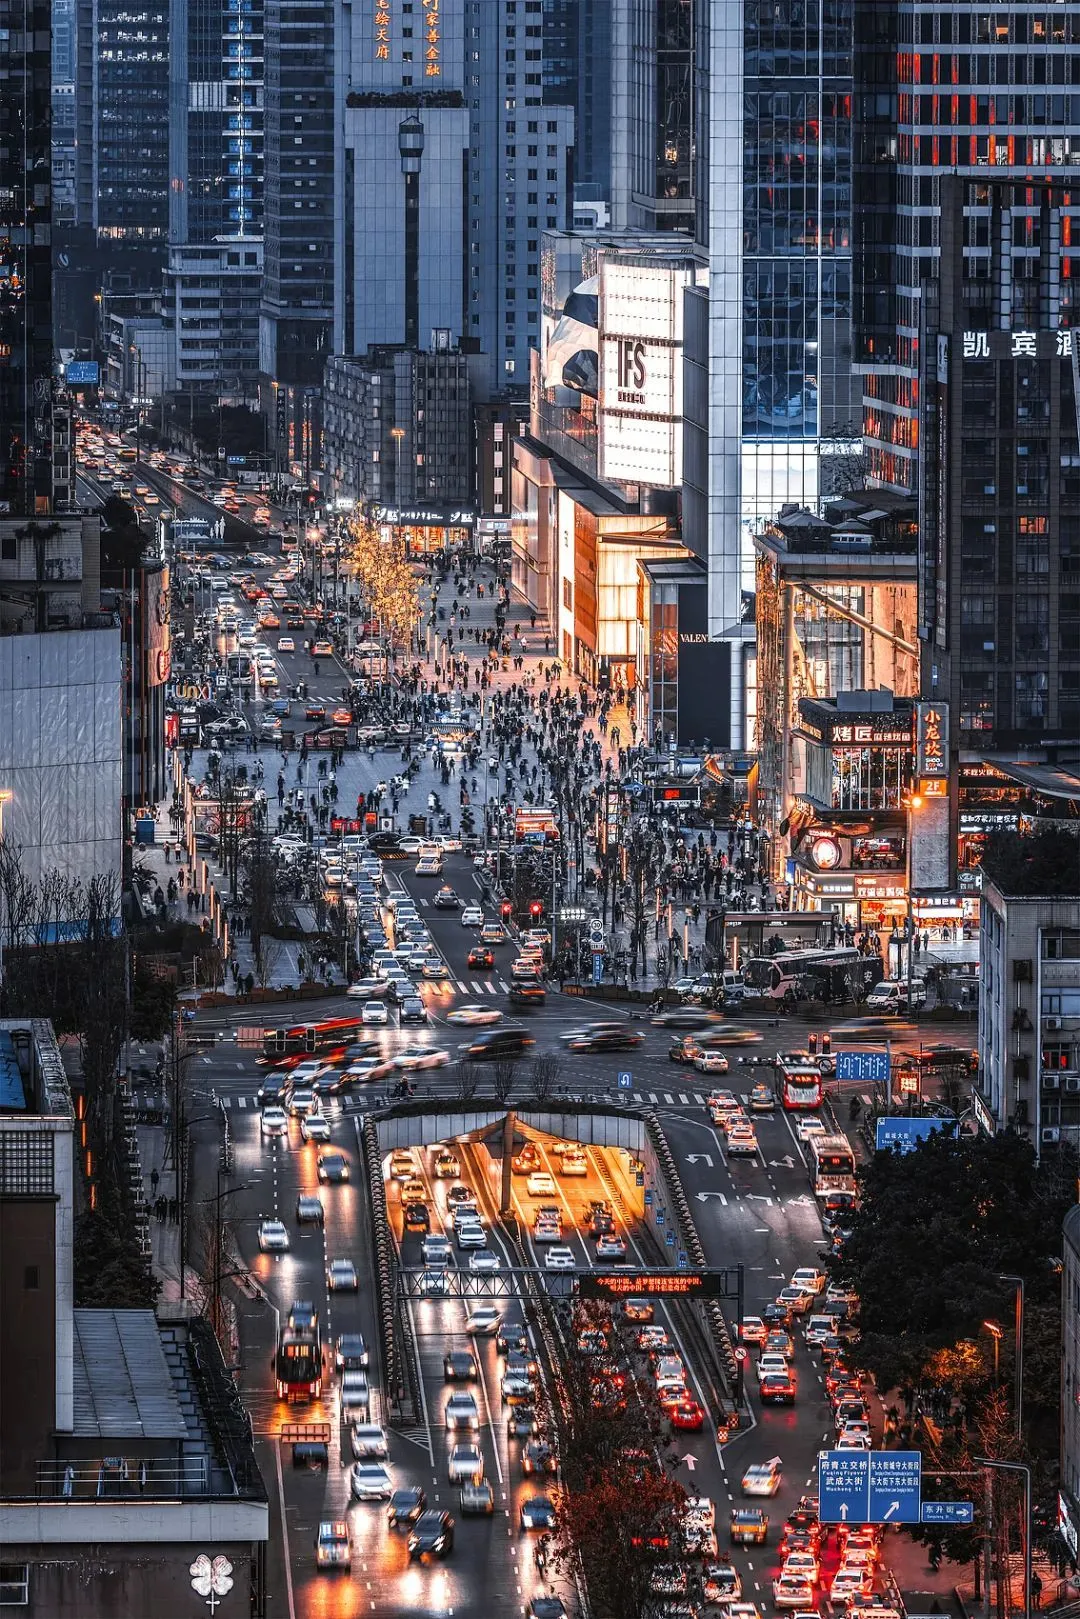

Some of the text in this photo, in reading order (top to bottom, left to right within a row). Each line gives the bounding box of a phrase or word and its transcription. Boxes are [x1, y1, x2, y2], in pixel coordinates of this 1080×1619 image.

[617, 340, 646, 389] IFS
[832, 726, 873, 742] 烤匠
[924, 709, 943, 756] 小龙坎
[926, 781, 940, 791] 2F
[821, 1460, 868, 1470] 府青立交桥
[825, 1477, 863, 1486] 武成大街
[870, 1477, 919, 1486] 东大街下东大街段
